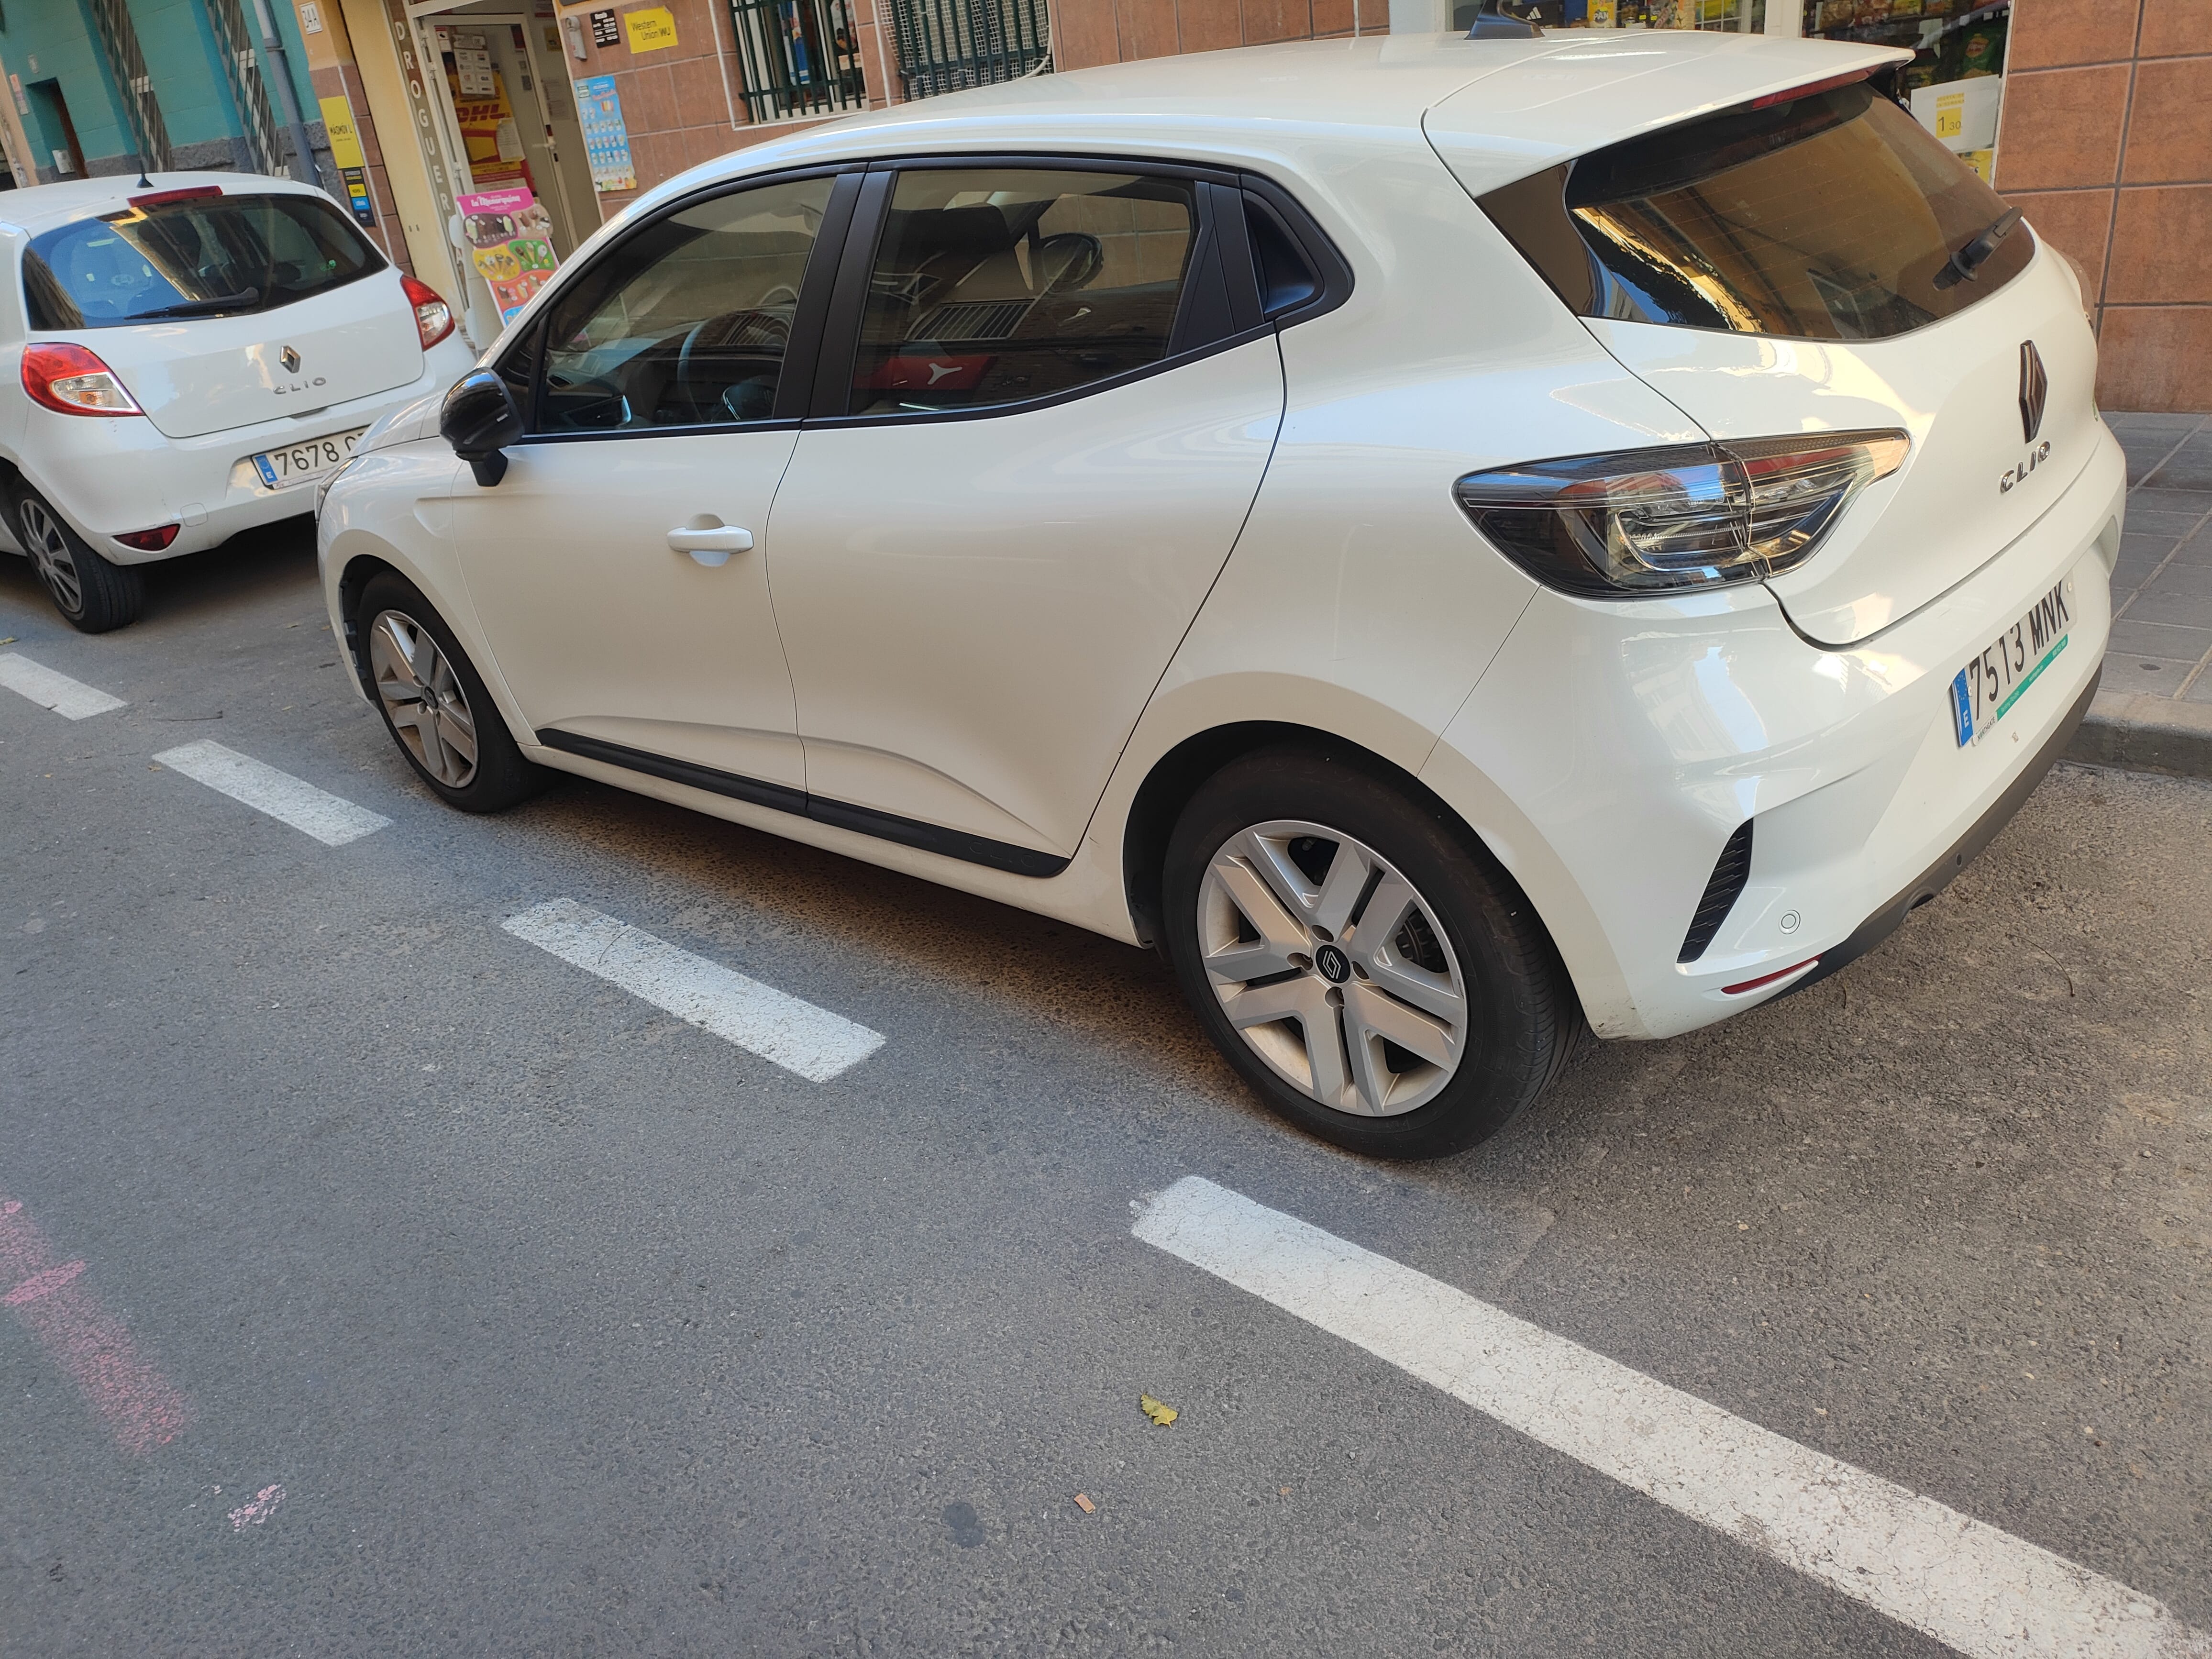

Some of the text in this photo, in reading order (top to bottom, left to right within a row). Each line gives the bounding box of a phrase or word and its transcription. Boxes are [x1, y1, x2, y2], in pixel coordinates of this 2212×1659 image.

[302, 8, 319, 28] 34A
[631, 20, 657, 31] Western
[641, 30, 658, 40] Union
[455, 104, 506, 122] DHL
[1938, 117, 1961, 132] 1 30
[396, 22, 463, 264] DROGUERA
[273, 377, 326, 395] CLIO
[274, 442, 339, 476] 7678
[2000, 441, 2050, 493] CLIO
[1963, 709, 1969, 729] E
[1969, 622, 2024, 721] 7513
[2028, 579, 2069, 656] MNK
[1977, 716, 1996, 741] NORTHGATE
